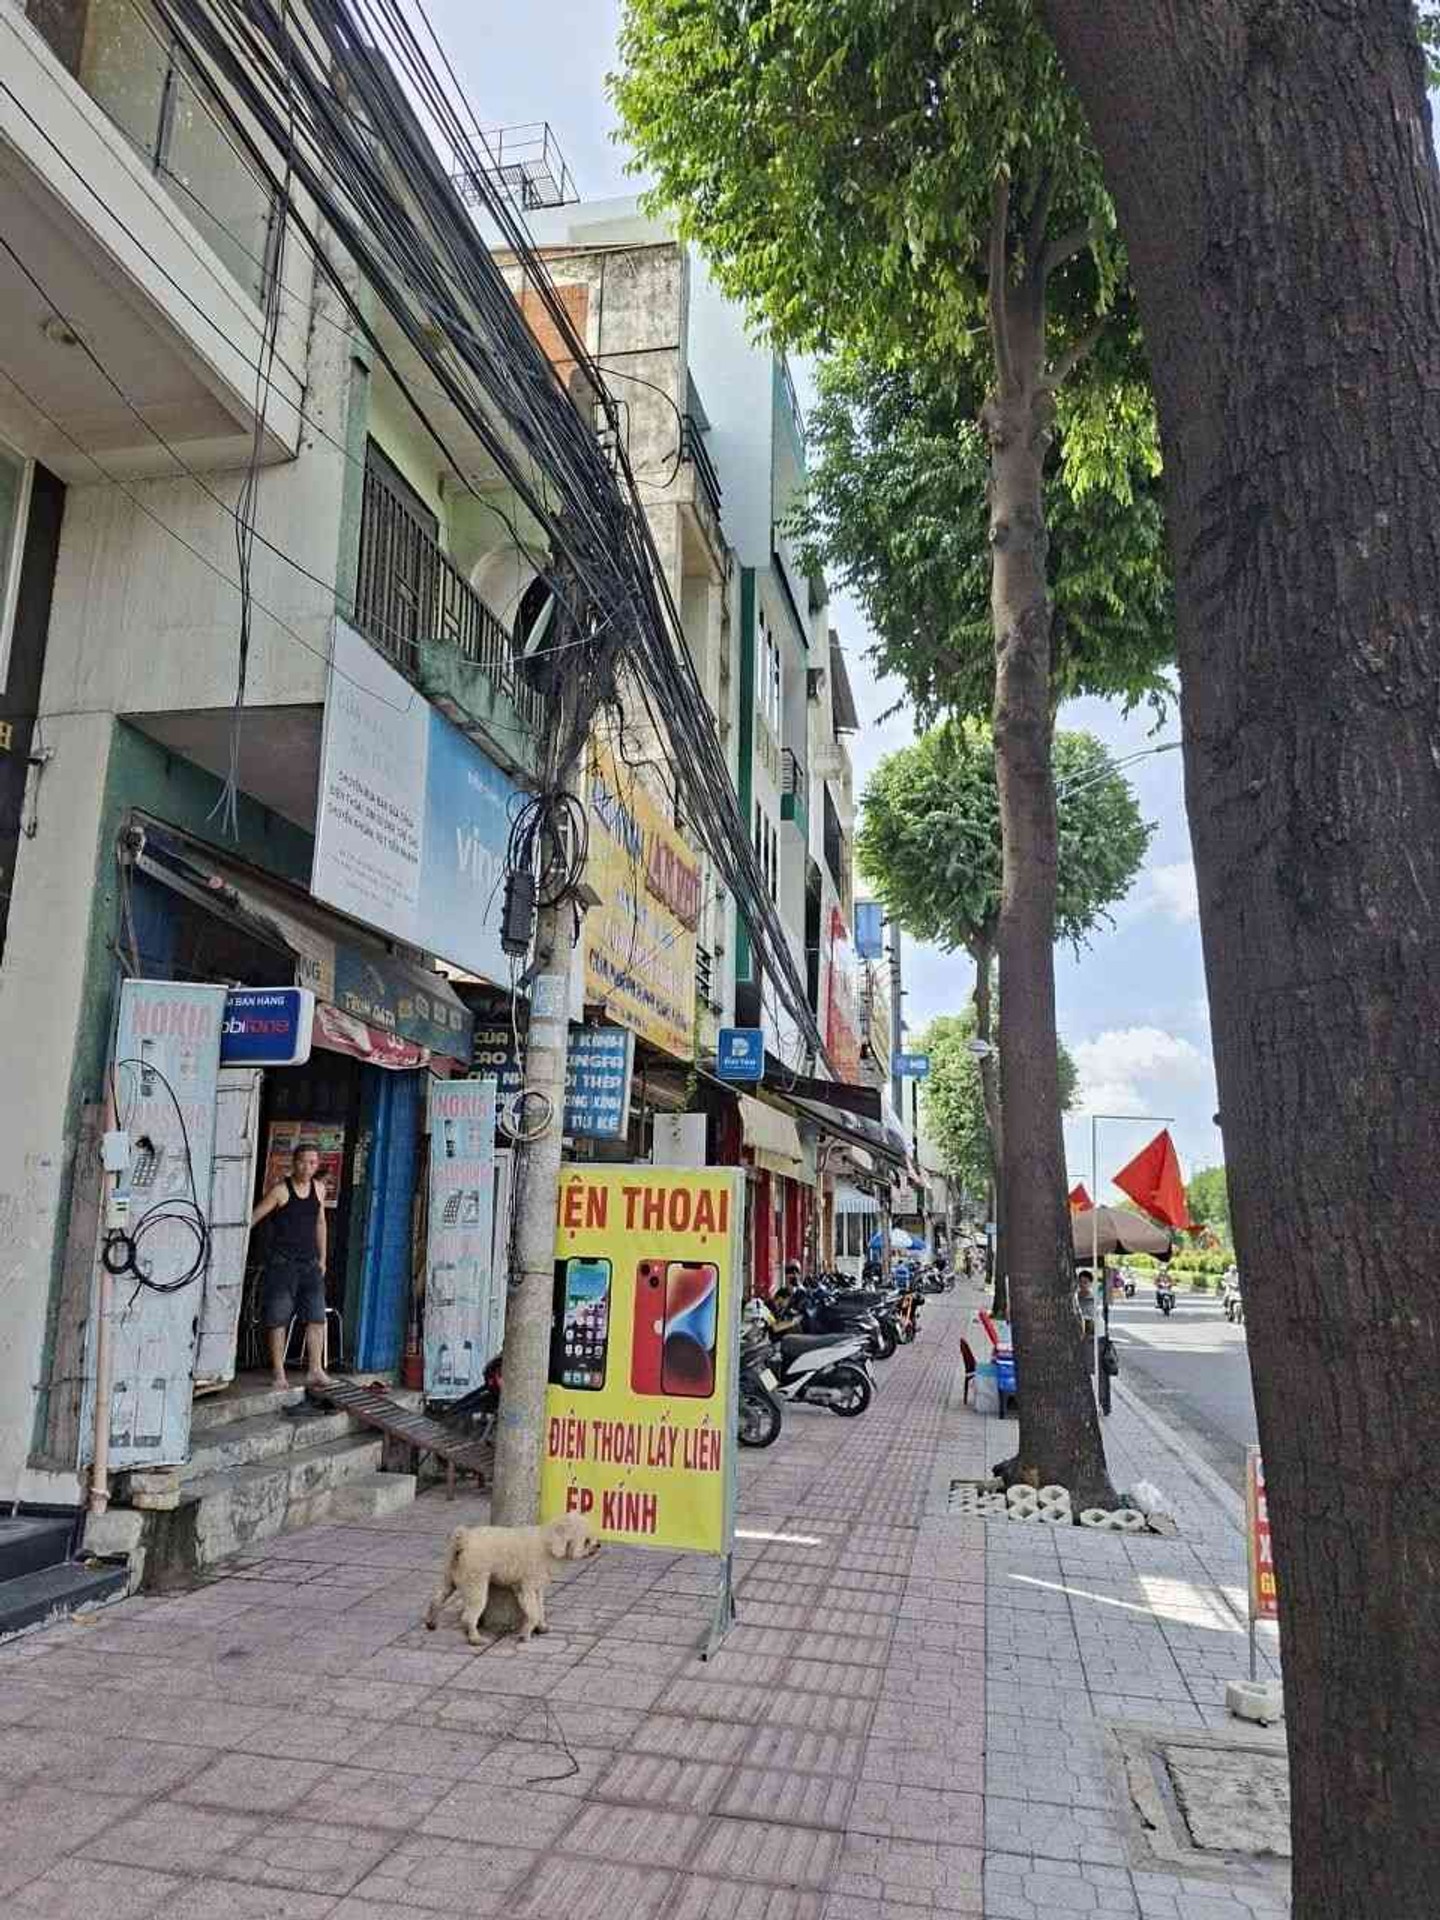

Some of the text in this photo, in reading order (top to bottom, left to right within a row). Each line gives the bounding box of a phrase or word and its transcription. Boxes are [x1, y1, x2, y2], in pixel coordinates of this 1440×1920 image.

[219, 1016, 289, 1034] obifone
[557, 1175, 729, 1244] IỆN THOẠI
[548, 1408, 586, 1469] ĐIỆN
[593, 1419, 642, 1475] THOẠI
[647, 1409, 678, 1468] LẤY
[602, 1480, 658, 1535] KÍNH
